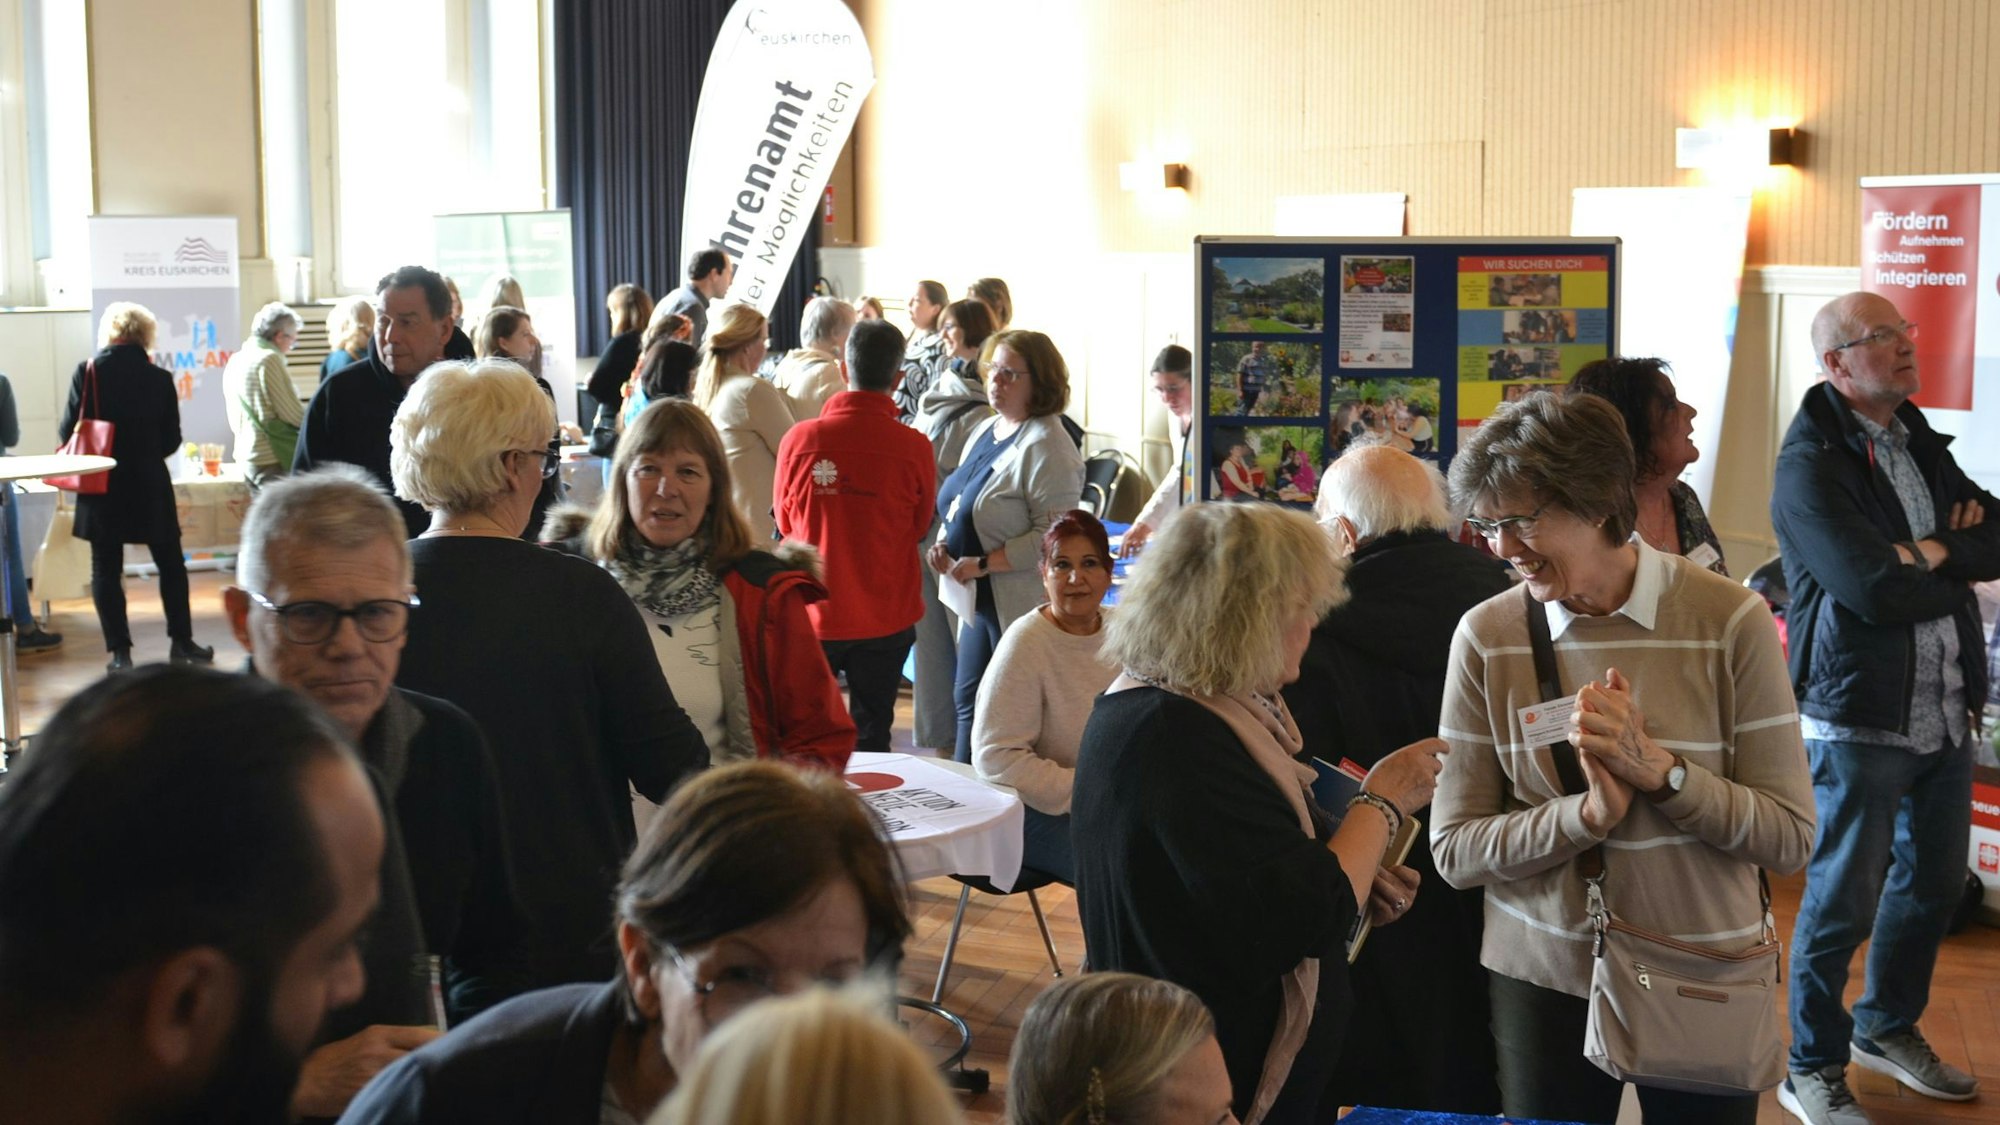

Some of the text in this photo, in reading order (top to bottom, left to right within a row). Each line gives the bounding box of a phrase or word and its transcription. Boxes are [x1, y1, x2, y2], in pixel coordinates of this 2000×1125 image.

[760, 32, 851, 45] euskirchen
[709, 80, 813, 285] hrenamt
[756, 81, 854, 266] Möglichkeiten
[1872, 211, 1948, 231] Fördern
[1900, 235, 1964, 247] Aufnehmen
[124, 266, 230, 276] KREIS EUSKIRCHEN
[1483, 259, 1583, 270] WIR SUCHEN DICH
[1875, 268, 1967, 287] Integrieren
[891, 787, 967, 811] AKTION
